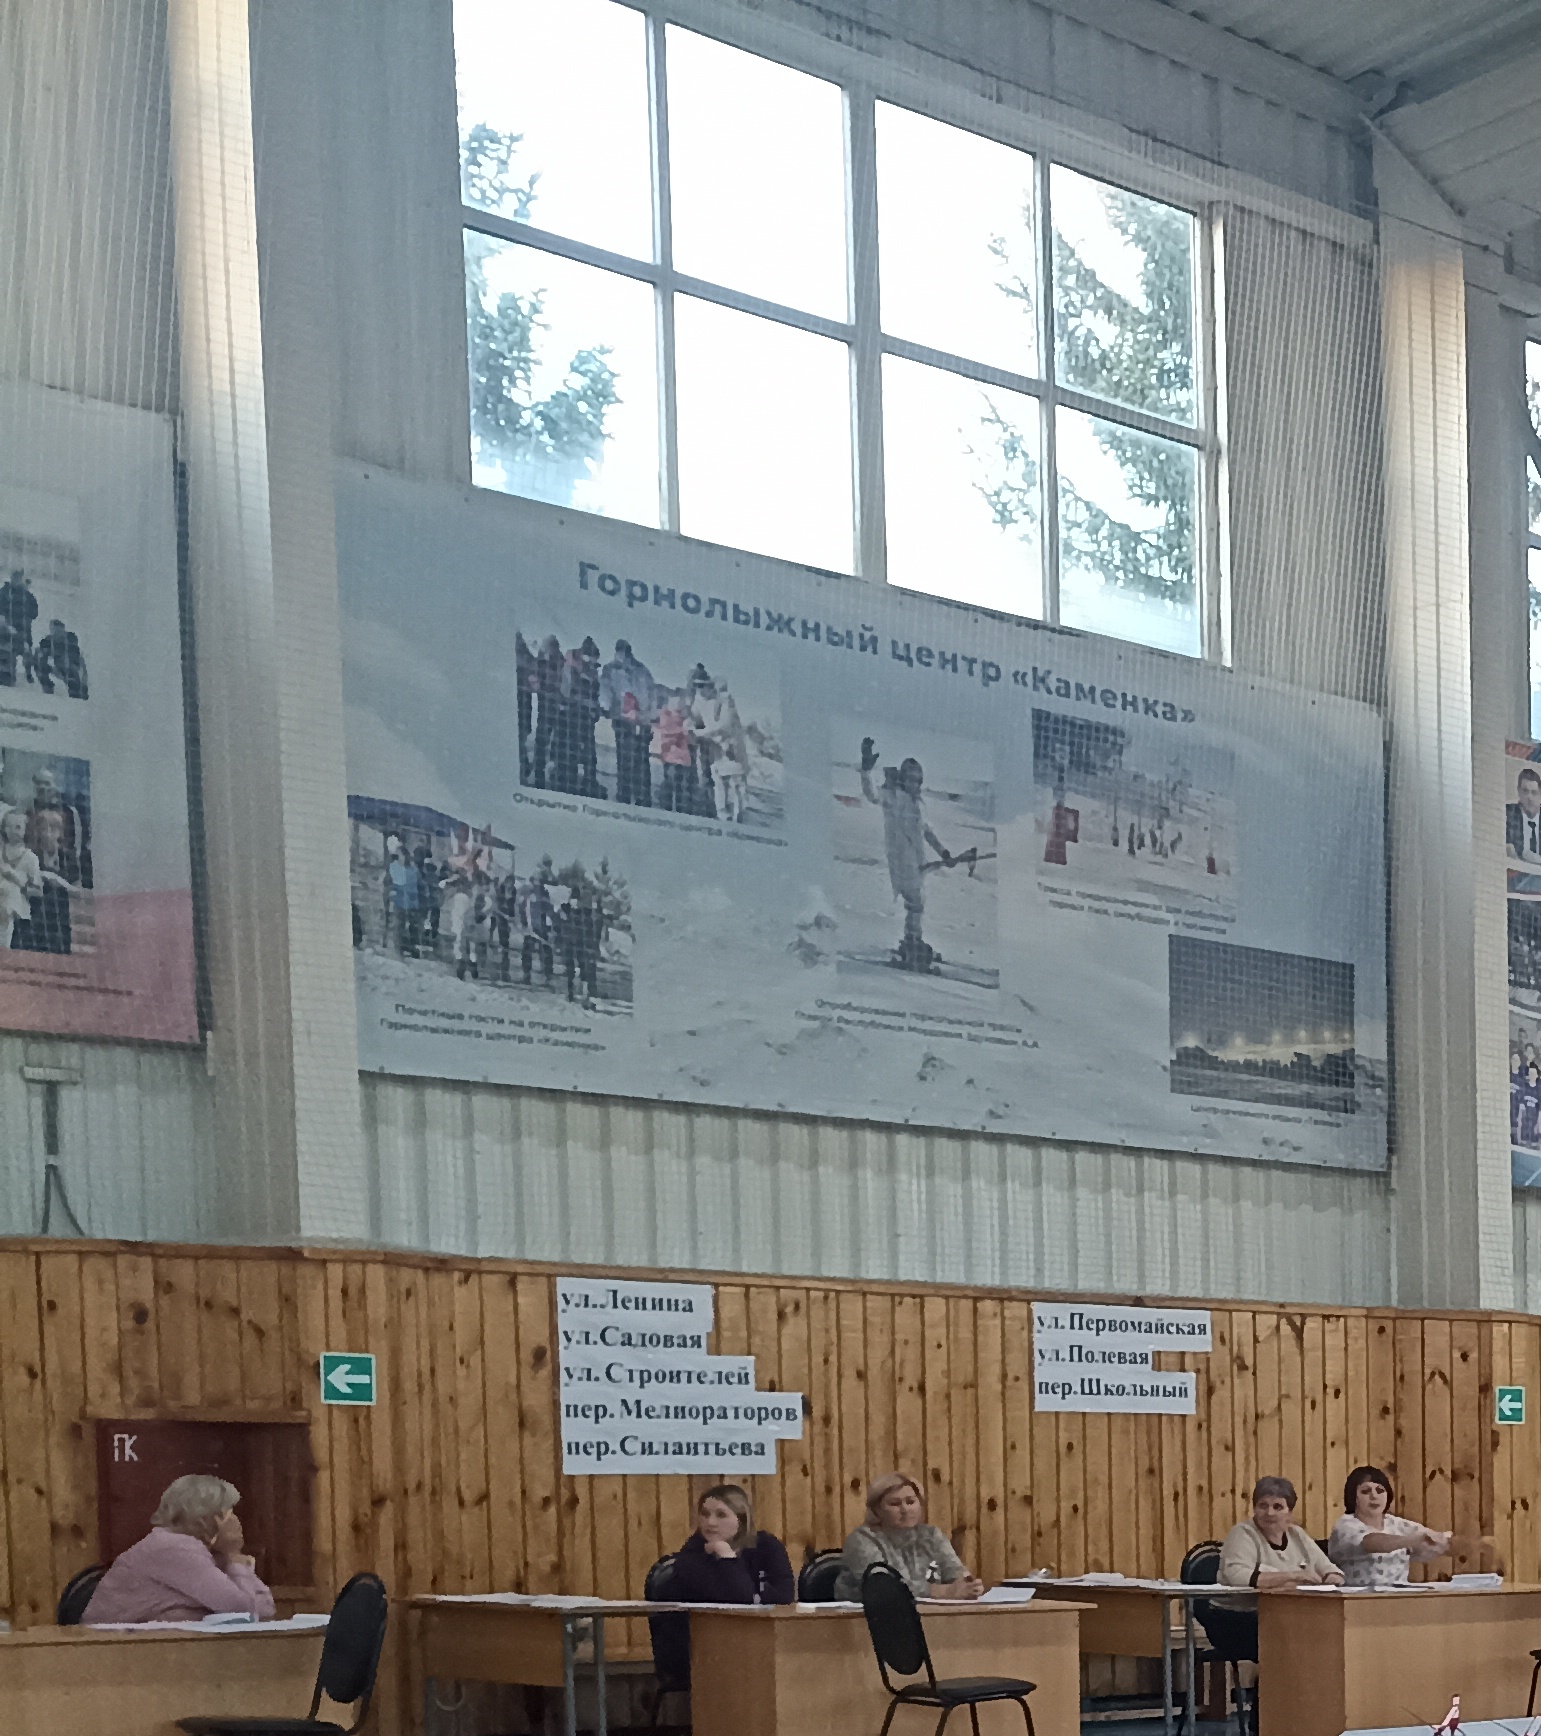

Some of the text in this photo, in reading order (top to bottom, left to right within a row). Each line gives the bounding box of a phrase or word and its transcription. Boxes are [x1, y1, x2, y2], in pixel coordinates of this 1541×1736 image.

[577, 560, 1197, 724] Горнолыжный центр «Каменка»
[113, 1433, 138, 1461] ПК
